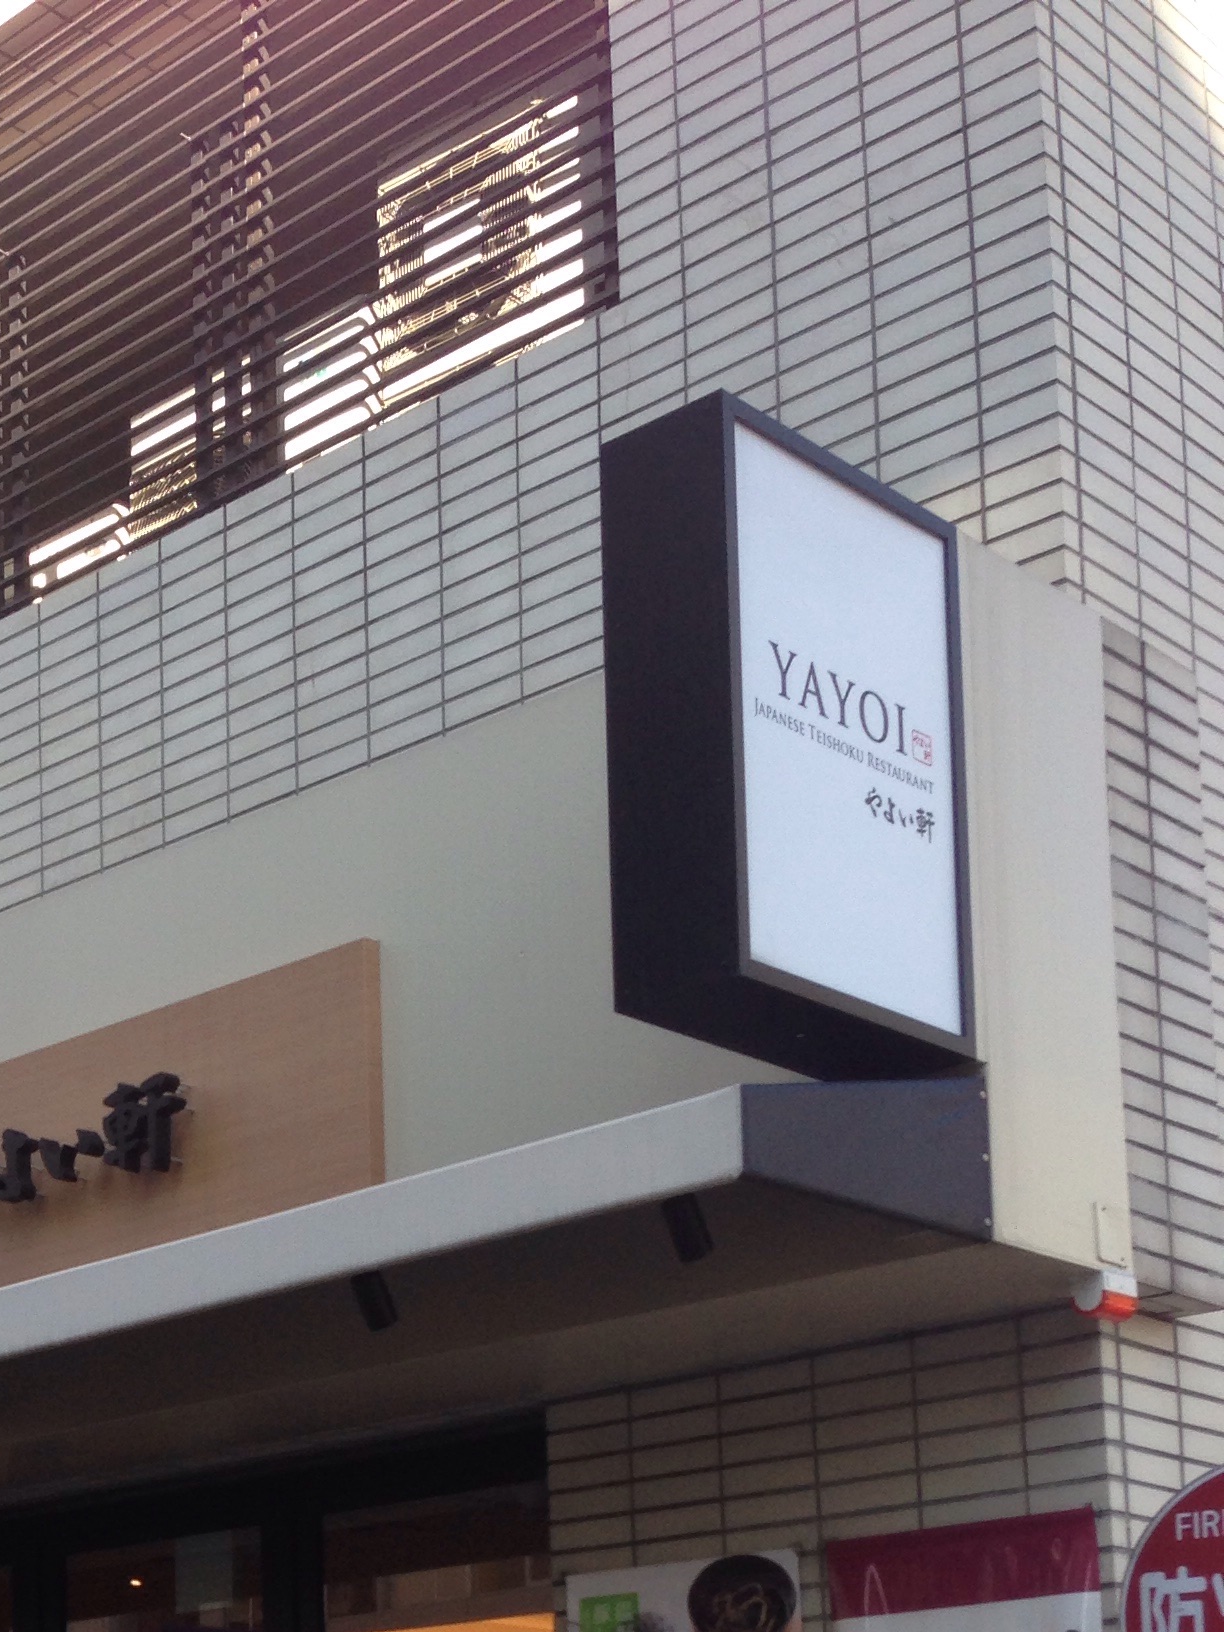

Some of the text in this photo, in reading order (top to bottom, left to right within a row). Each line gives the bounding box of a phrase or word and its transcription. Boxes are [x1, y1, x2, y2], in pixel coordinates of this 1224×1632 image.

[768, 640, 908, 756] YAYOI
[754, 698, 805, 736] JAPANESE
[867, 752, 934, 795] RESTAURANT
[864, 787, 935, 843] やよい軒
[1175, 1507, 1224, 1541] FIR
